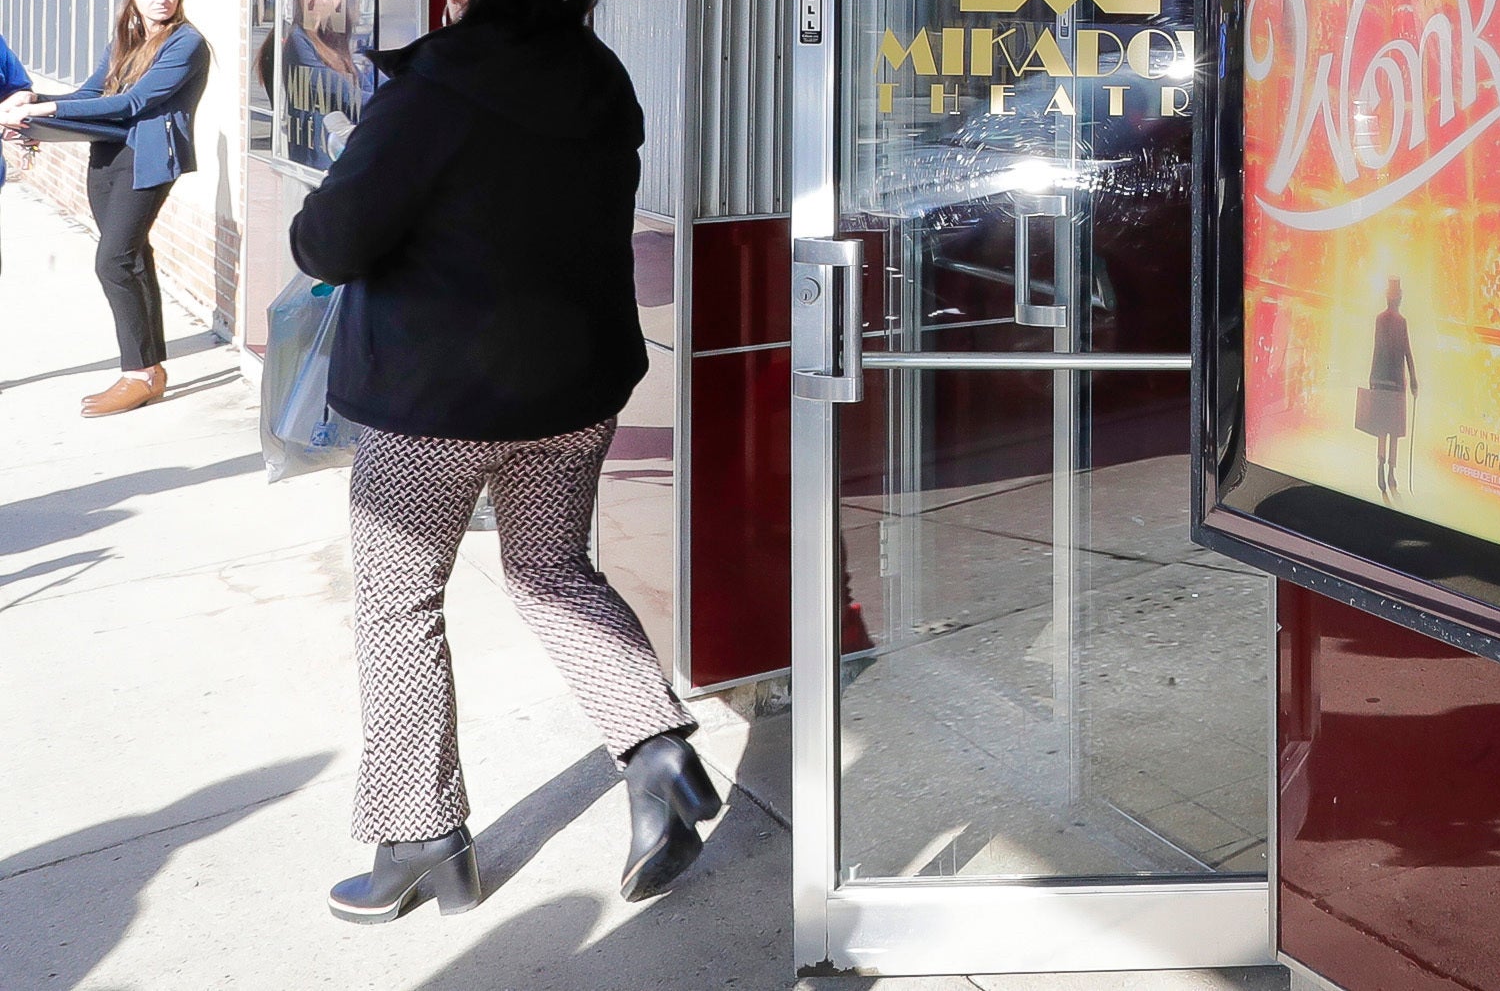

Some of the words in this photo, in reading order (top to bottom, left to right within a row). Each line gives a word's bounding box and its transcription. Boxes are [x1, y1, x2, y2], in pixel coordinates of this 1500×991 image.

[876, 82, 1190, 117] THEATR
[1459, 425, 1478, 437] ONLY
[1480, 430, 1488, 441] IN
[1446, 435, 1470, 462] This
